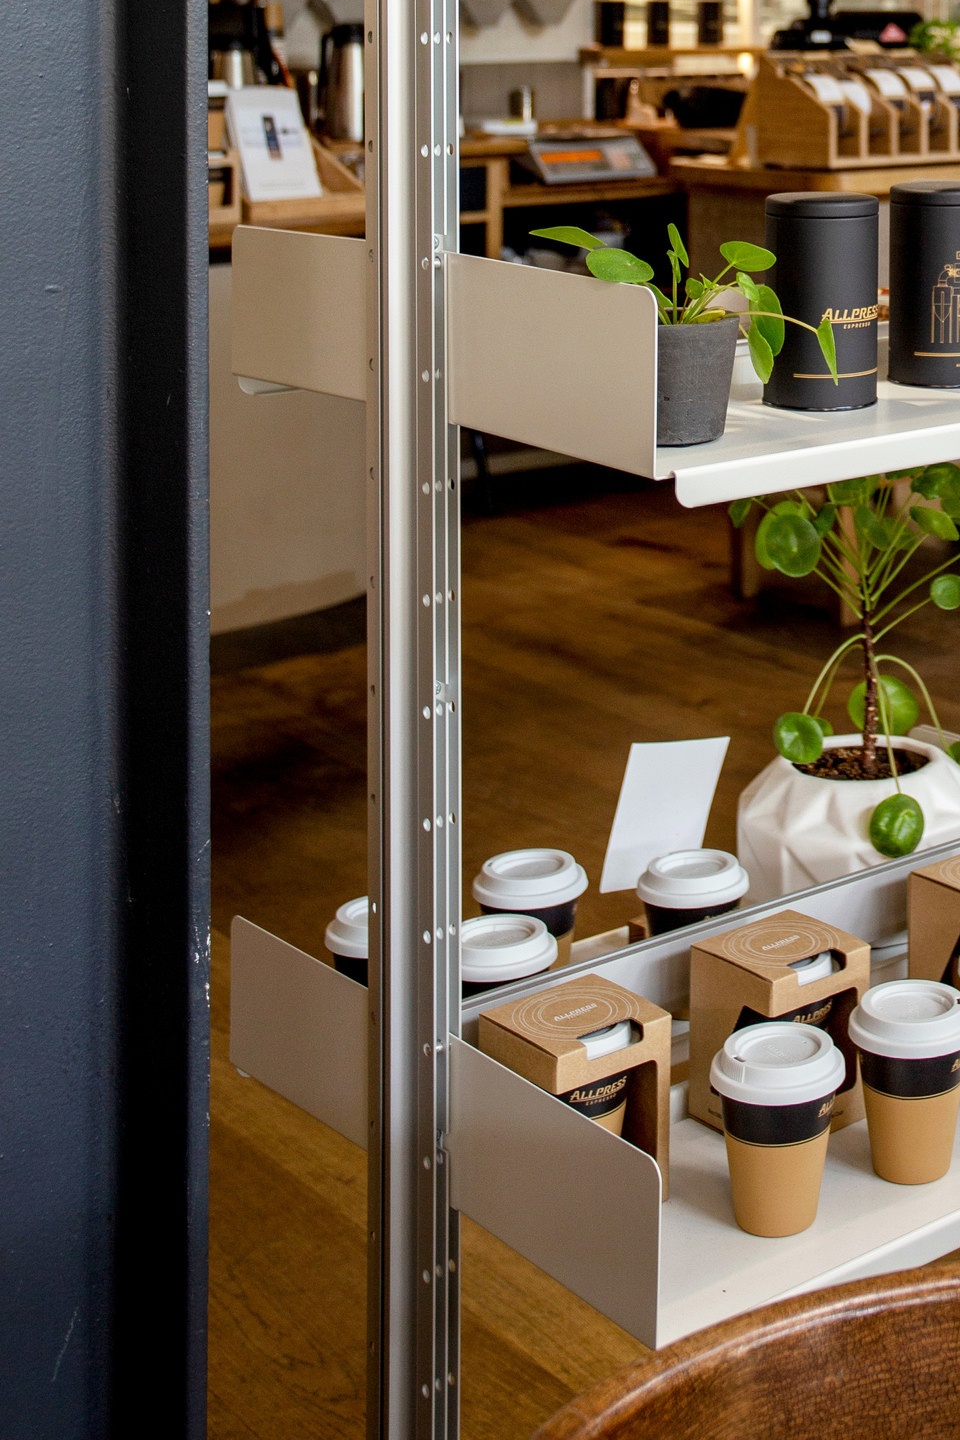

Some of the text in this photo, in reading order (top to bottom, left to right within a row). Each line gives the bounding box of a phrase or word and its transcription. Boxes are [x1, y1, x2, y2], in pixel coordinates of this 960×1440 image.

[843, 321, 871, 330] ESPRESSO
[553, 1002, 598, 1022] ALLPRESS
[569, 1075, 628, 1103] ALLPRESS
